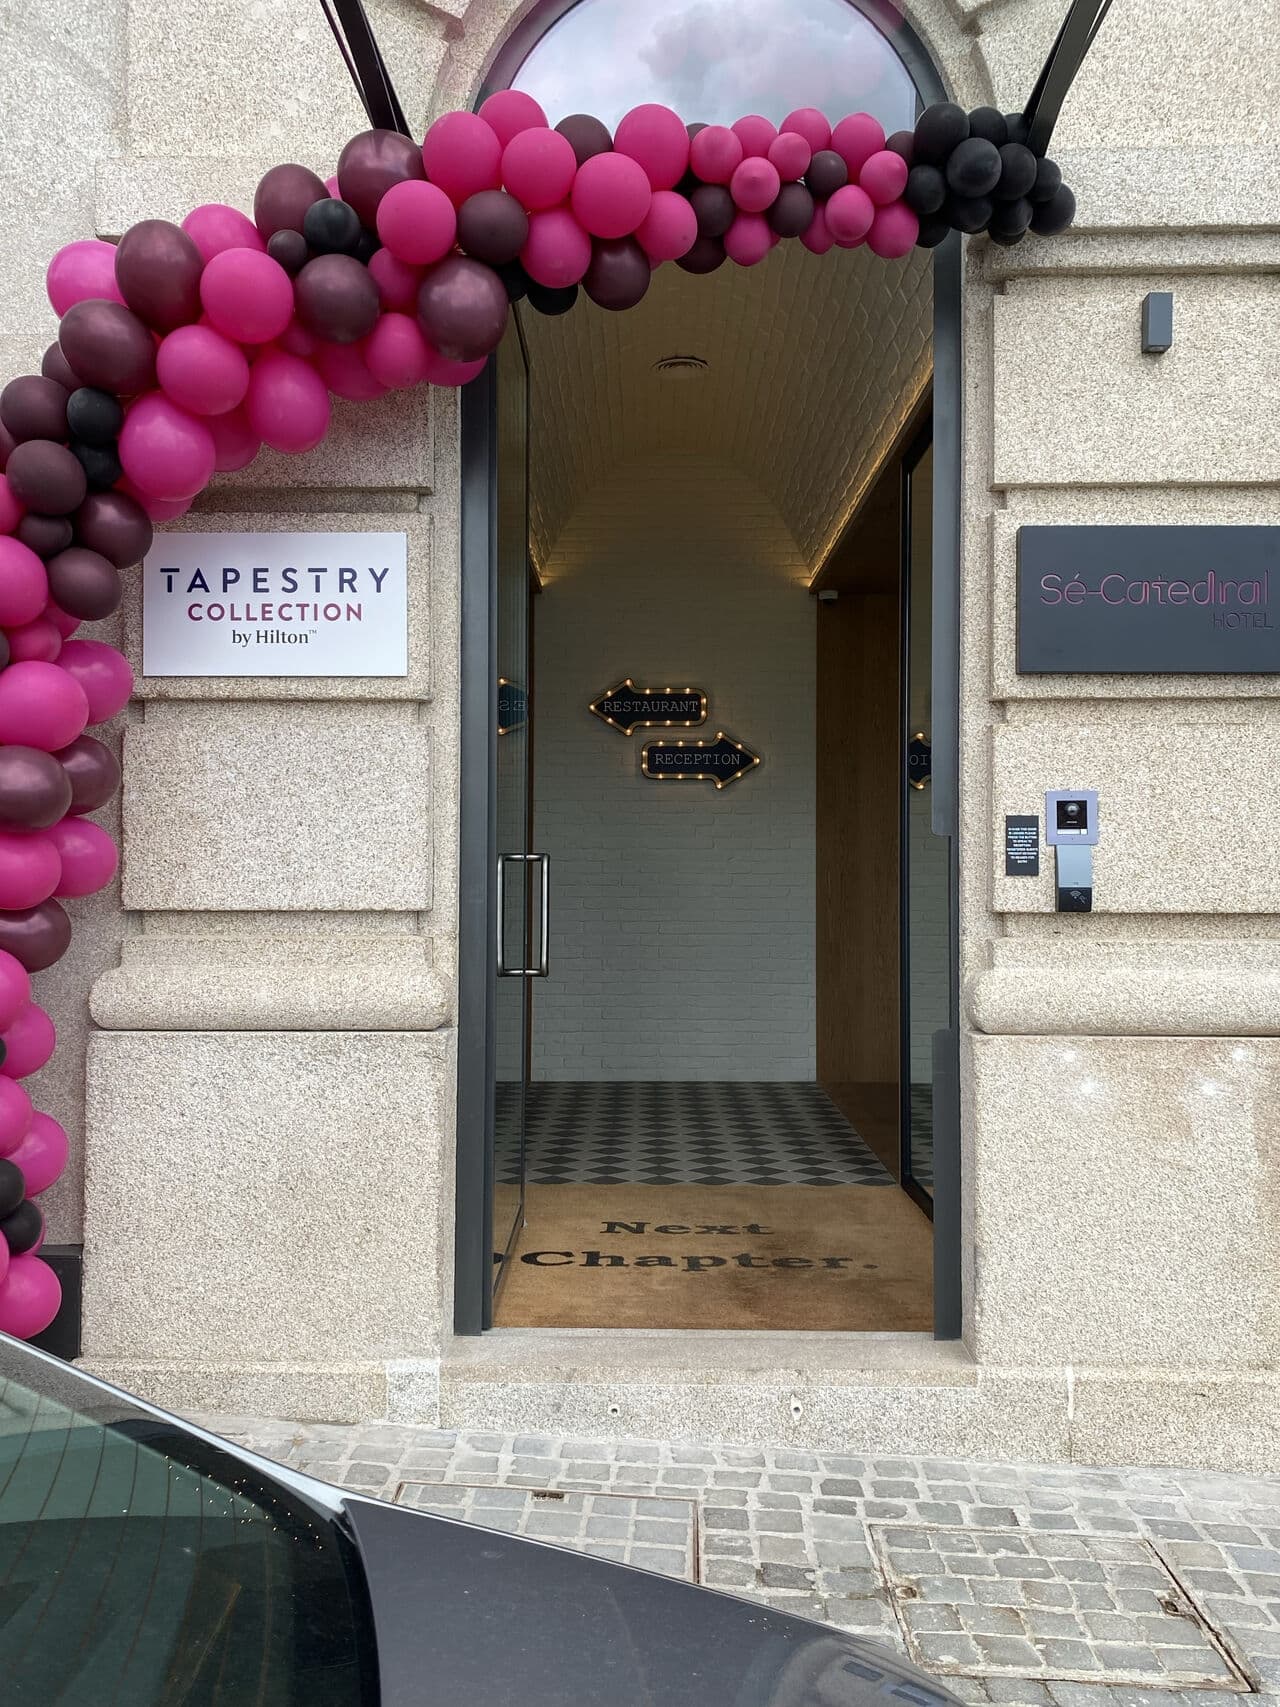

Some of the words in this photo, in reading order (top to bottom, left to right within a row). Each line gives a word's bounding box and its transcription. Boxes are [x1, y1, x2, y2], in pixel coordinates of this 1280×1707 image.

[160, 567, 390, 593] TAPESTRY
[187, 603, 362, 622] COLLECTION
[1213, 612, 1273, 630] HOTEL
[232, 630, 252, 647] by
[603, 701, 698, 712] RESTAURANT
[655, 753, 740, 765] RECEPTION
[601, 1221, 774, 1235] Next
[520, 1250, 879, 1272] Chapter.
